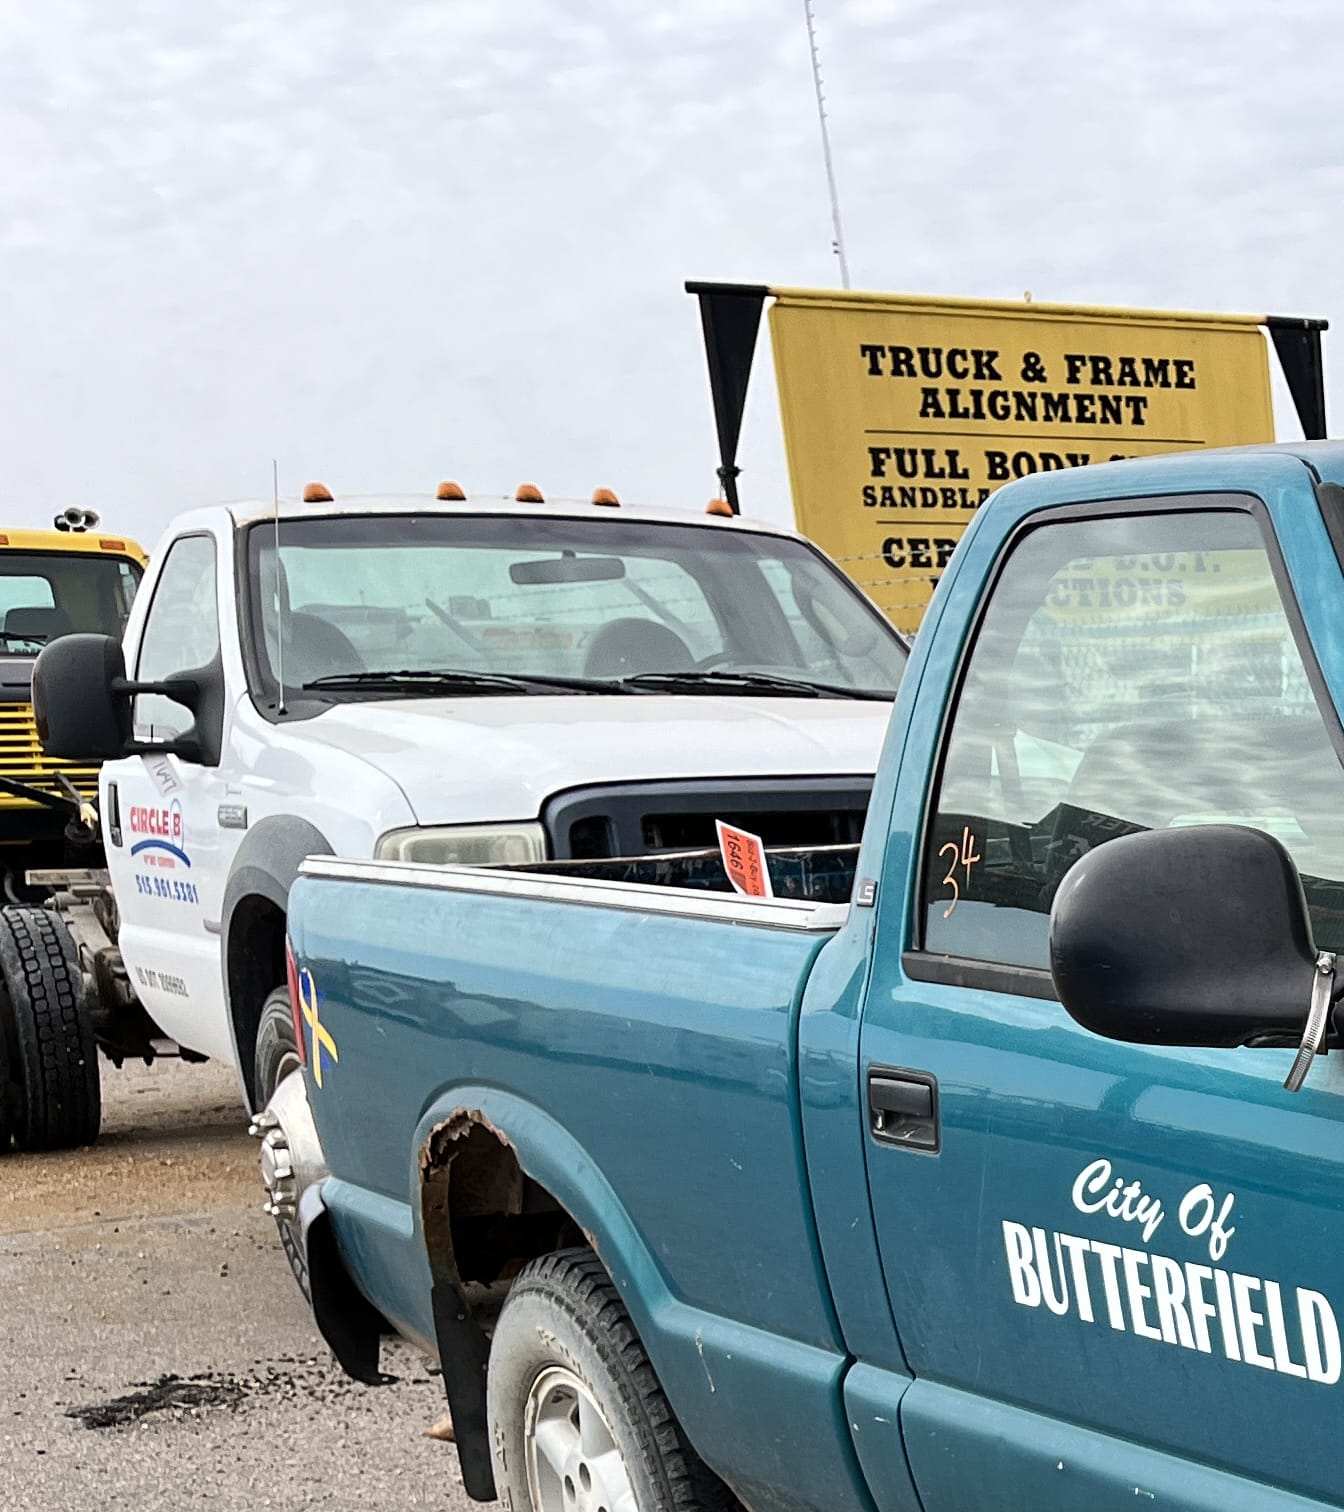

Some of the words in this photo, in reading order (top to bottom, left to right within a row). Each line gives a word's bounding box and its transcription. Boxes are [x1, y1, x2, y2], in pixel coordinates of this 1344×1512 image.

[860, 344, 1002, 381] TRUCK
[1020, 352, 1047, 383] &
[1064, 354, 1196, 389] FRAME
[919, 387, 1148, 425] ALIGNMENT
[868, 447, 970, 480] FULL
[130, 806, 169, 836] CIRCLE
[173, 812, 181, 837] B
[1072, 1158, 1165, 1243] City
[1178, 1183, 1236, 1261] Of
[1002, 1220, 1342, 1385] BUTTERFIELD
